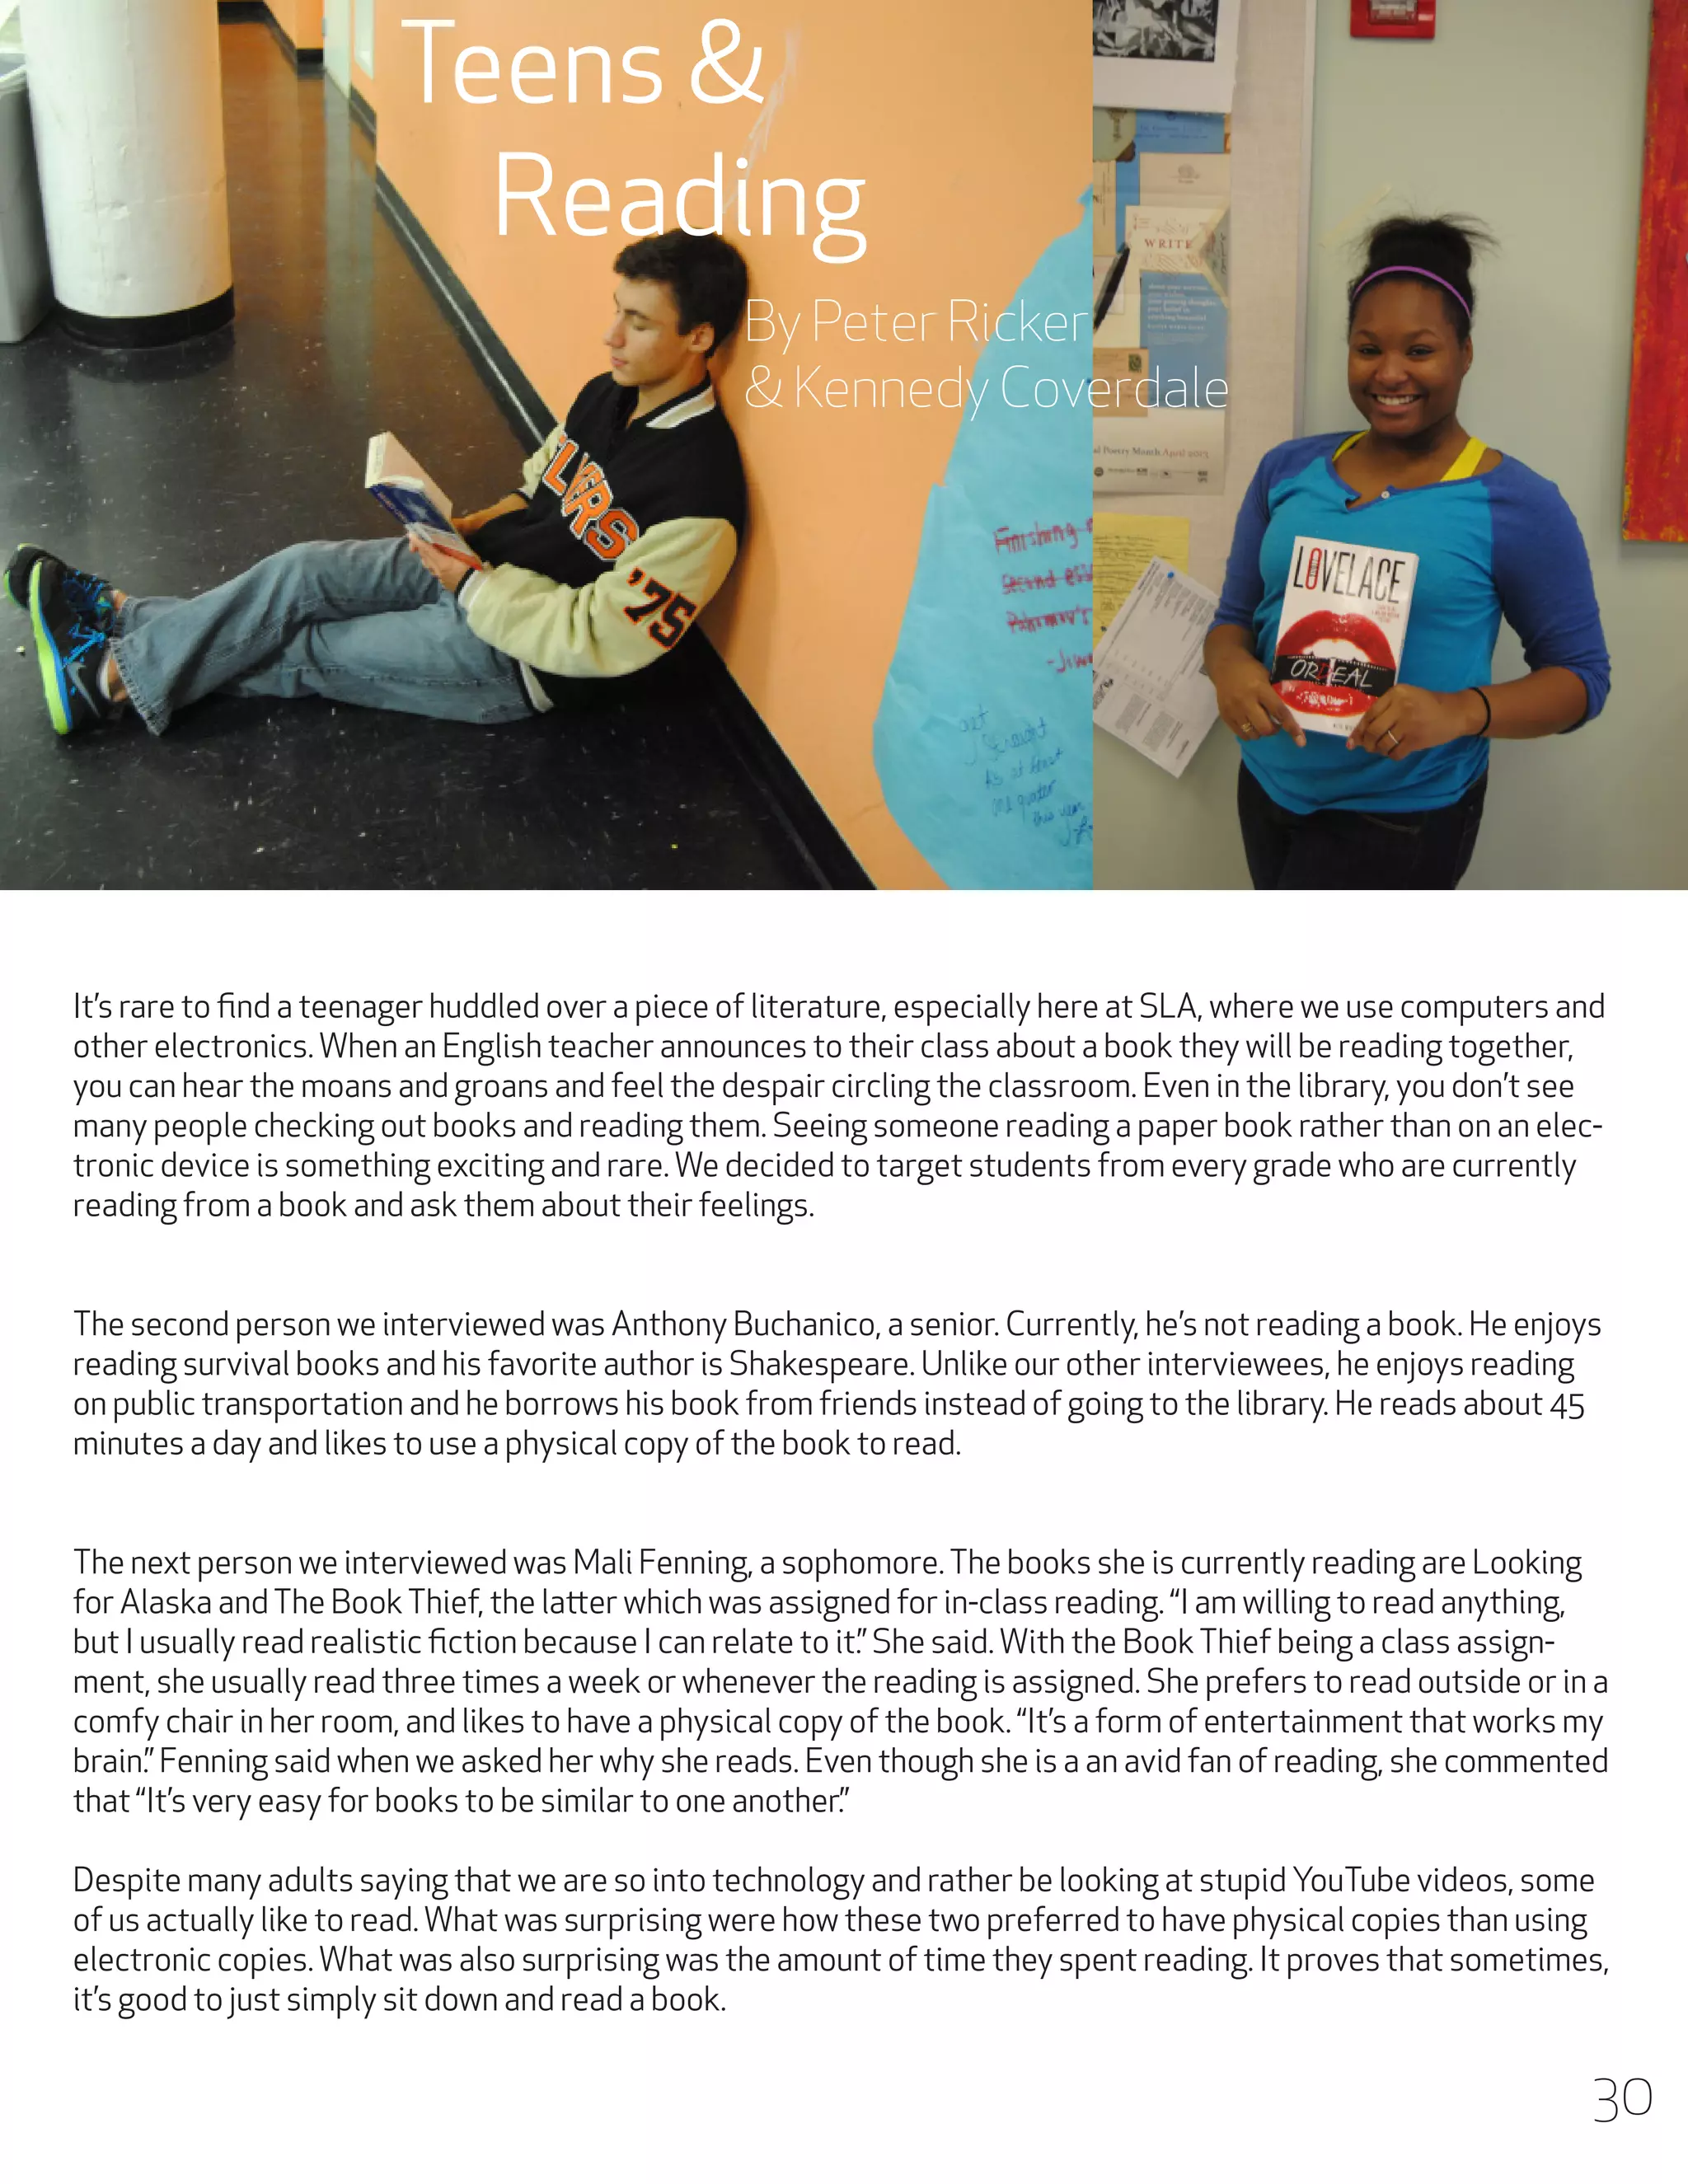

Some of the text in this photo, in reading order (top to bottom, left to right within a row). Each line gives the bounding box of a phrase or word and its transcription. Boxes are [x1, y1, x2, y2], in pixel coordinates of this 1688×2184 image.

[1145, 239, 1193, 249] WRITE
[1104, 446, 1130, 459] Poetry
[1132, 447, 1160, 457] Month
[1162, 447, 1186, 459] April
[1293, 546, 1406, 604] LOVELACE
[73, 1032, 1573, 1066] other electronics. When an English teacher announces to their class about a book they will be reading together,
[74, 1190, 814, 1226] reading from a book and ask them about their feelings.
[74, 1389, 1585, 1424] on public transportation and he borrows his book from friends instead of going to the library. He reads about 45
[73, 1548, 1582, 1583] The next person we interviewed was Mali Fenning, a sophomore. The books she is currently reading are Looking
[74, 1866, 1595, 1900] Despite many adults saying that we are so into technology and rather be looking at stupid YouTube videos, some
[74, 1945, 1609, 1980] electronic copies. What was also surprising was the amount of time they spent reading. It proves that sometimes,
[1593, 2077, 1653, 2124] 30
